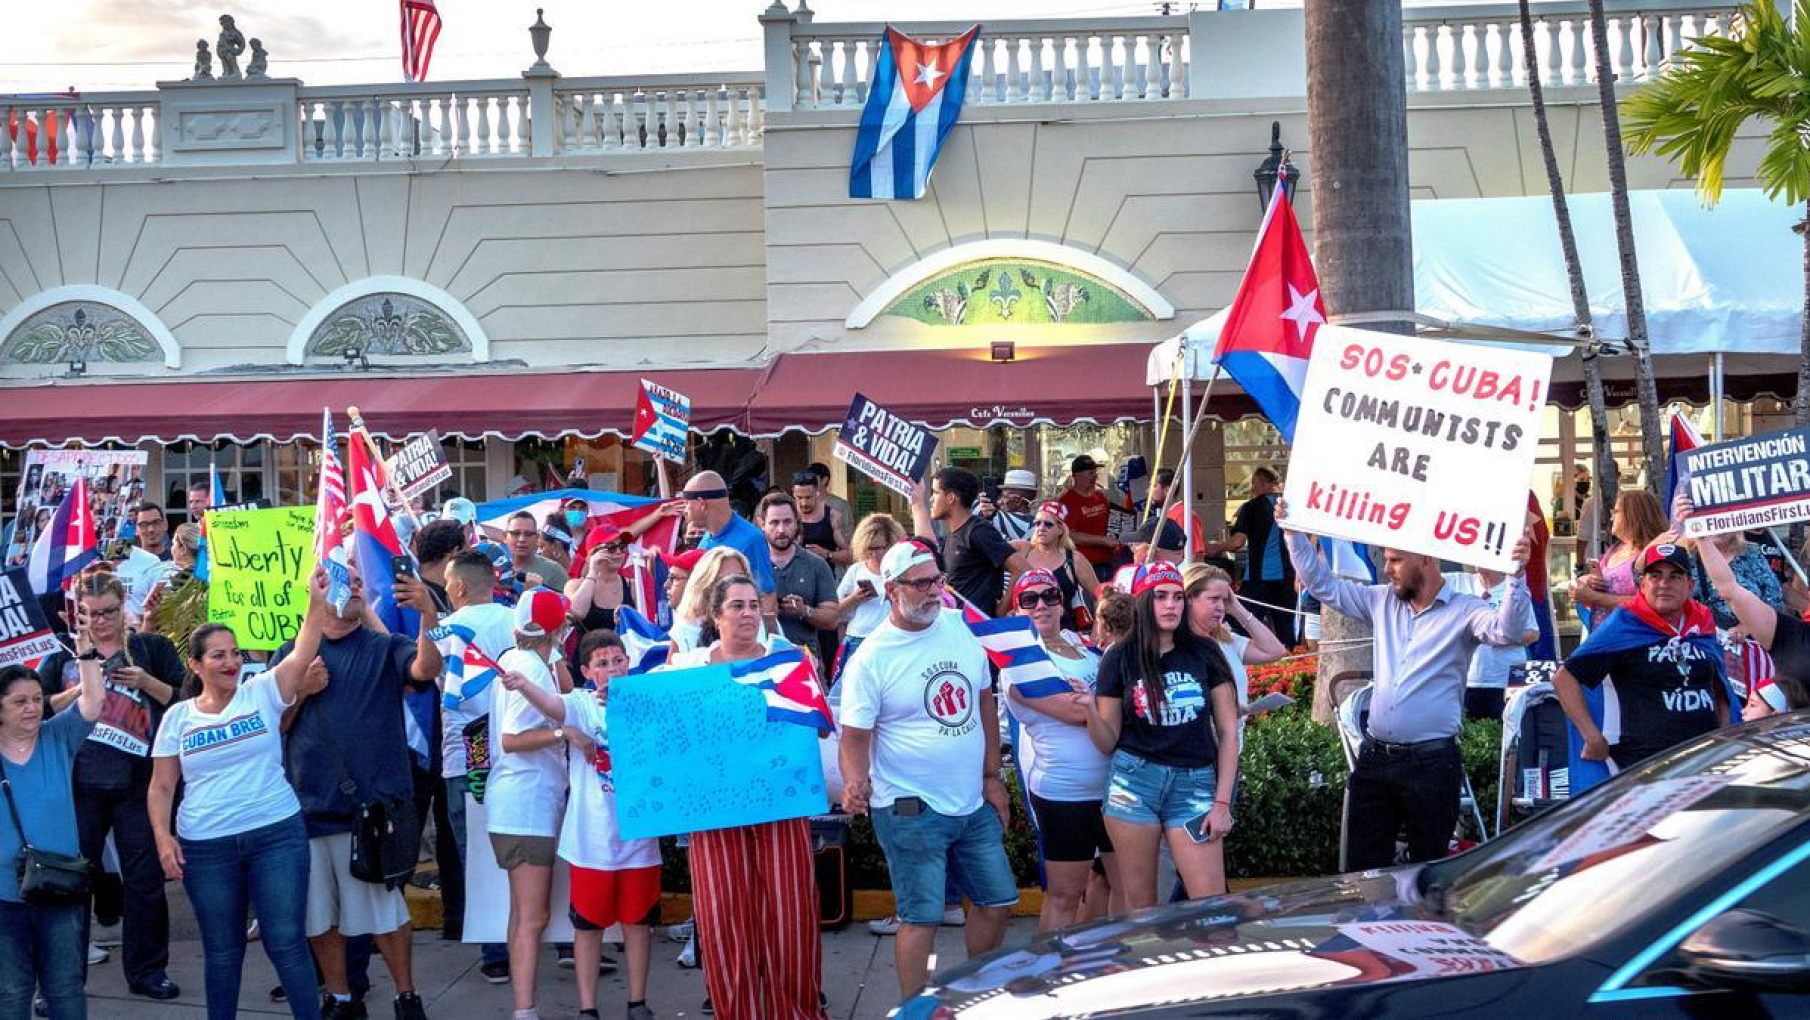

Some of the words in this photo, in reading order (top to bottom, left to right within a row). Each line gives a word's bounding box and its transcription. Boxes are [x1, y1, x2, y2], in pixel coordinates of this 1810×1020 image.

[1340, 344, 1411, 381] SOS
[1429, 361, 1541, 412] CUBA!
[858, 401, 925, 456] PATRIA
[1323, 387, 1523, 451] COMMUNISTS
[405, 450, 440, 481] VIDA!
[853, 426, 868, 450] &
[870, 432, 917, 477] VIDA!
[1367, 442, 1431, 482] ARE
[1687, 433, 1806, 473] INTERVENCIÓN
[1690, 459, 1810, 508] MILITAR
[1306, 481, 1412, 530] killing
[1434, 511, 1507, 556] US!!
[210, 530, 303, 580] Liberty
[274, 580, 292, 606] of
[182, 727, 227, 751] CUBAN
